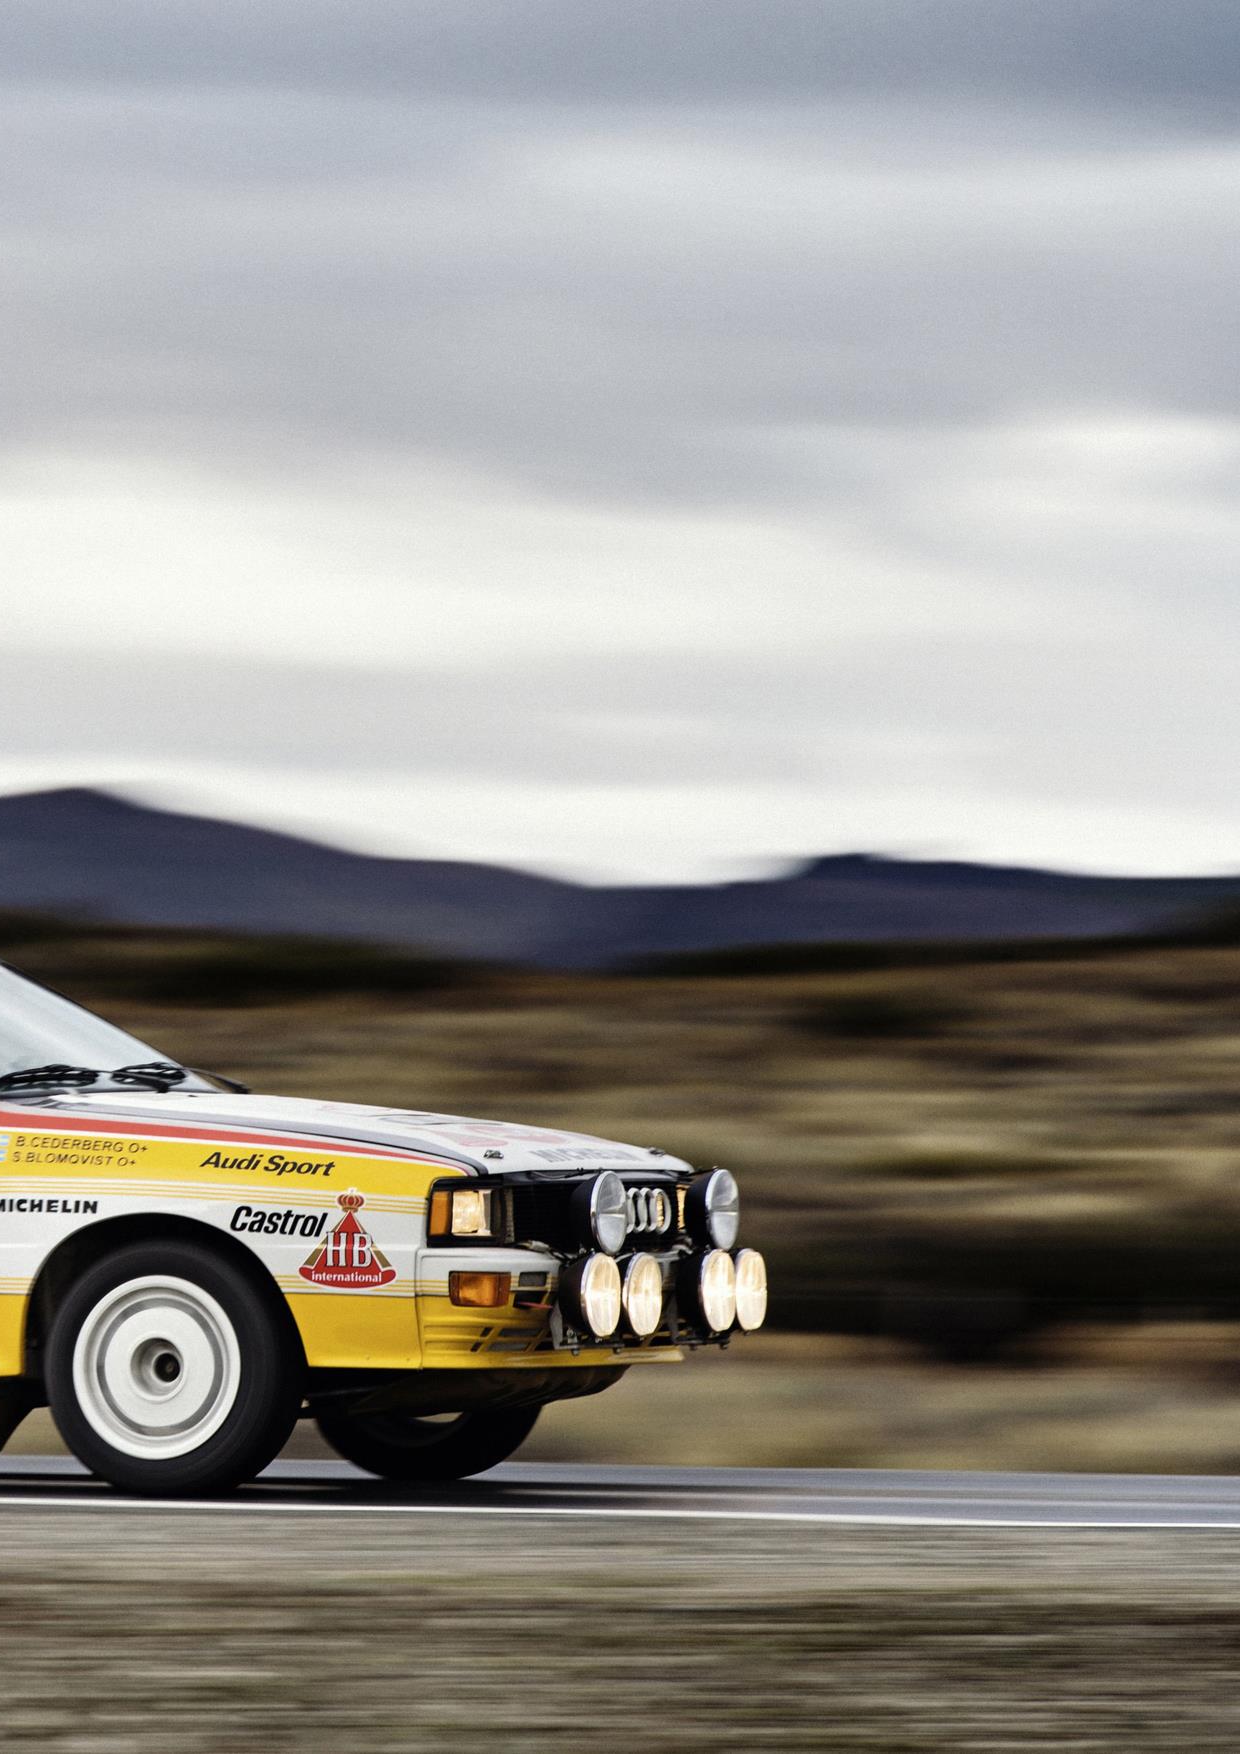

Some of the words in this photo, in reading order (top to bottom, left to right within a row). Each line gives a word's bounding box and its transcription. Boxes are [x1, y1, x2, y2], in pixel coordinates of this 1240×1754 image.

[200, 1151, 263, 1171] Audi
[263, 1155, 336, 1176] Sport
[230, 1205, 328, 1238] Castrol
[325, 1231, 374, 1268] HB
[311, 1270, 383, 1284] international
